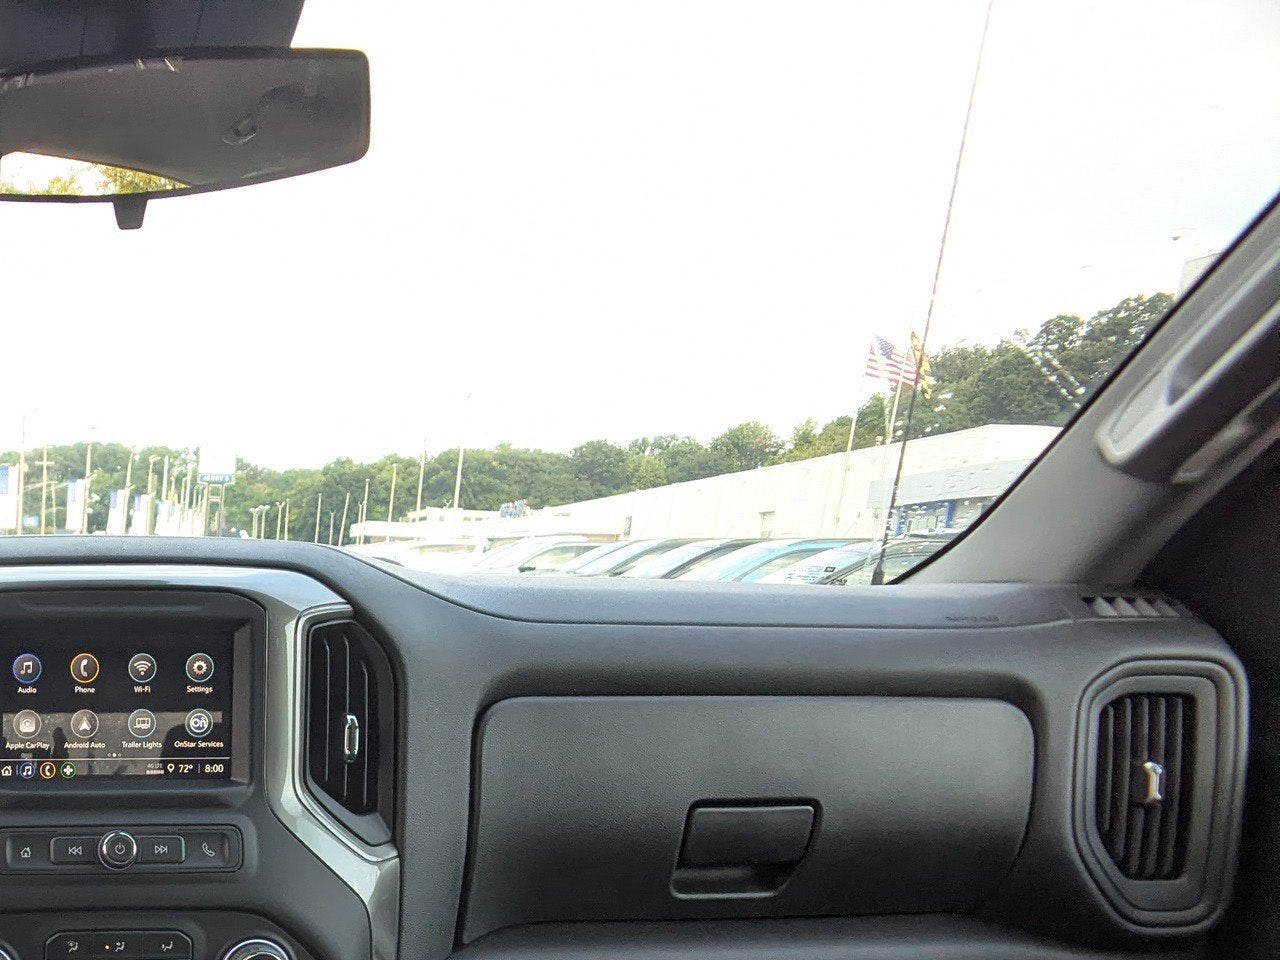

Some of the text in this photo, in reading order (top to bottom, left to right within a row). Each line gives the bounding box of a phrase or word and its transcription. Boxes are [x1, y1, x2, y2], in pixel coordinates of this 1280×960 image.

[133, 685, 151, 693] Wi-Fi
[186, 685, 213, 694] Settings
[5, 742, 50, 750] Apple CarPlay
[64, 741, 106, 749] Android Auto
[143, 741, 162, 749] Lights
[204, 763, 224, 773] 8:00
